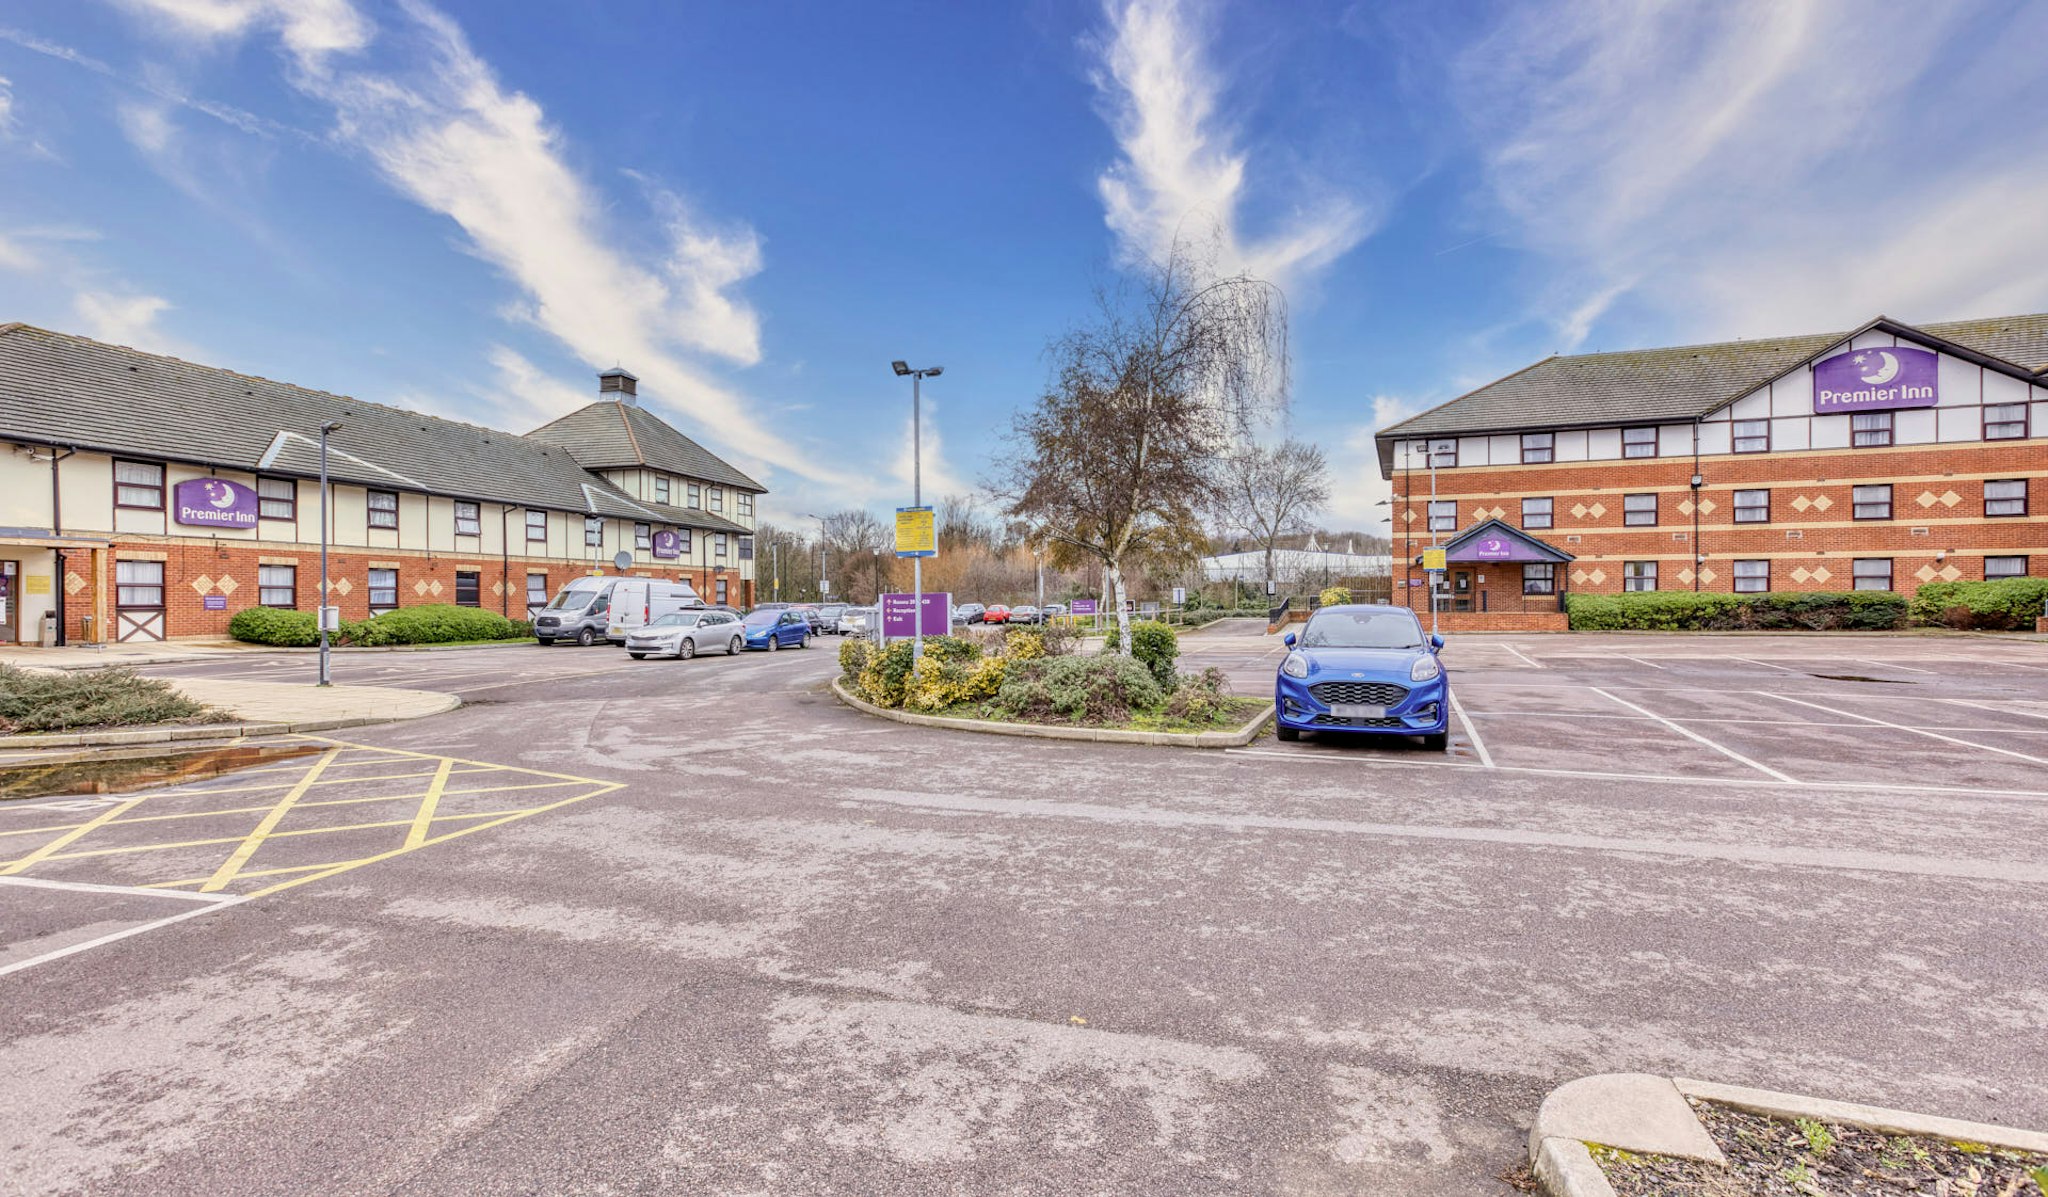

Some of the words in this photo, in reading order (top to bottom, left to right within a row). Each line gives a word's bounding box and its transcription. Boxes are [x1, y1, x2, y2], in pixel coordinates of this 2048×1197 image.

[1820, 387, 1897, 405] Premier
[1901, 384, 1933, 400] Inn
[182, 506, 235, 521] Premier
[235, 510, 256, 523] Inn
